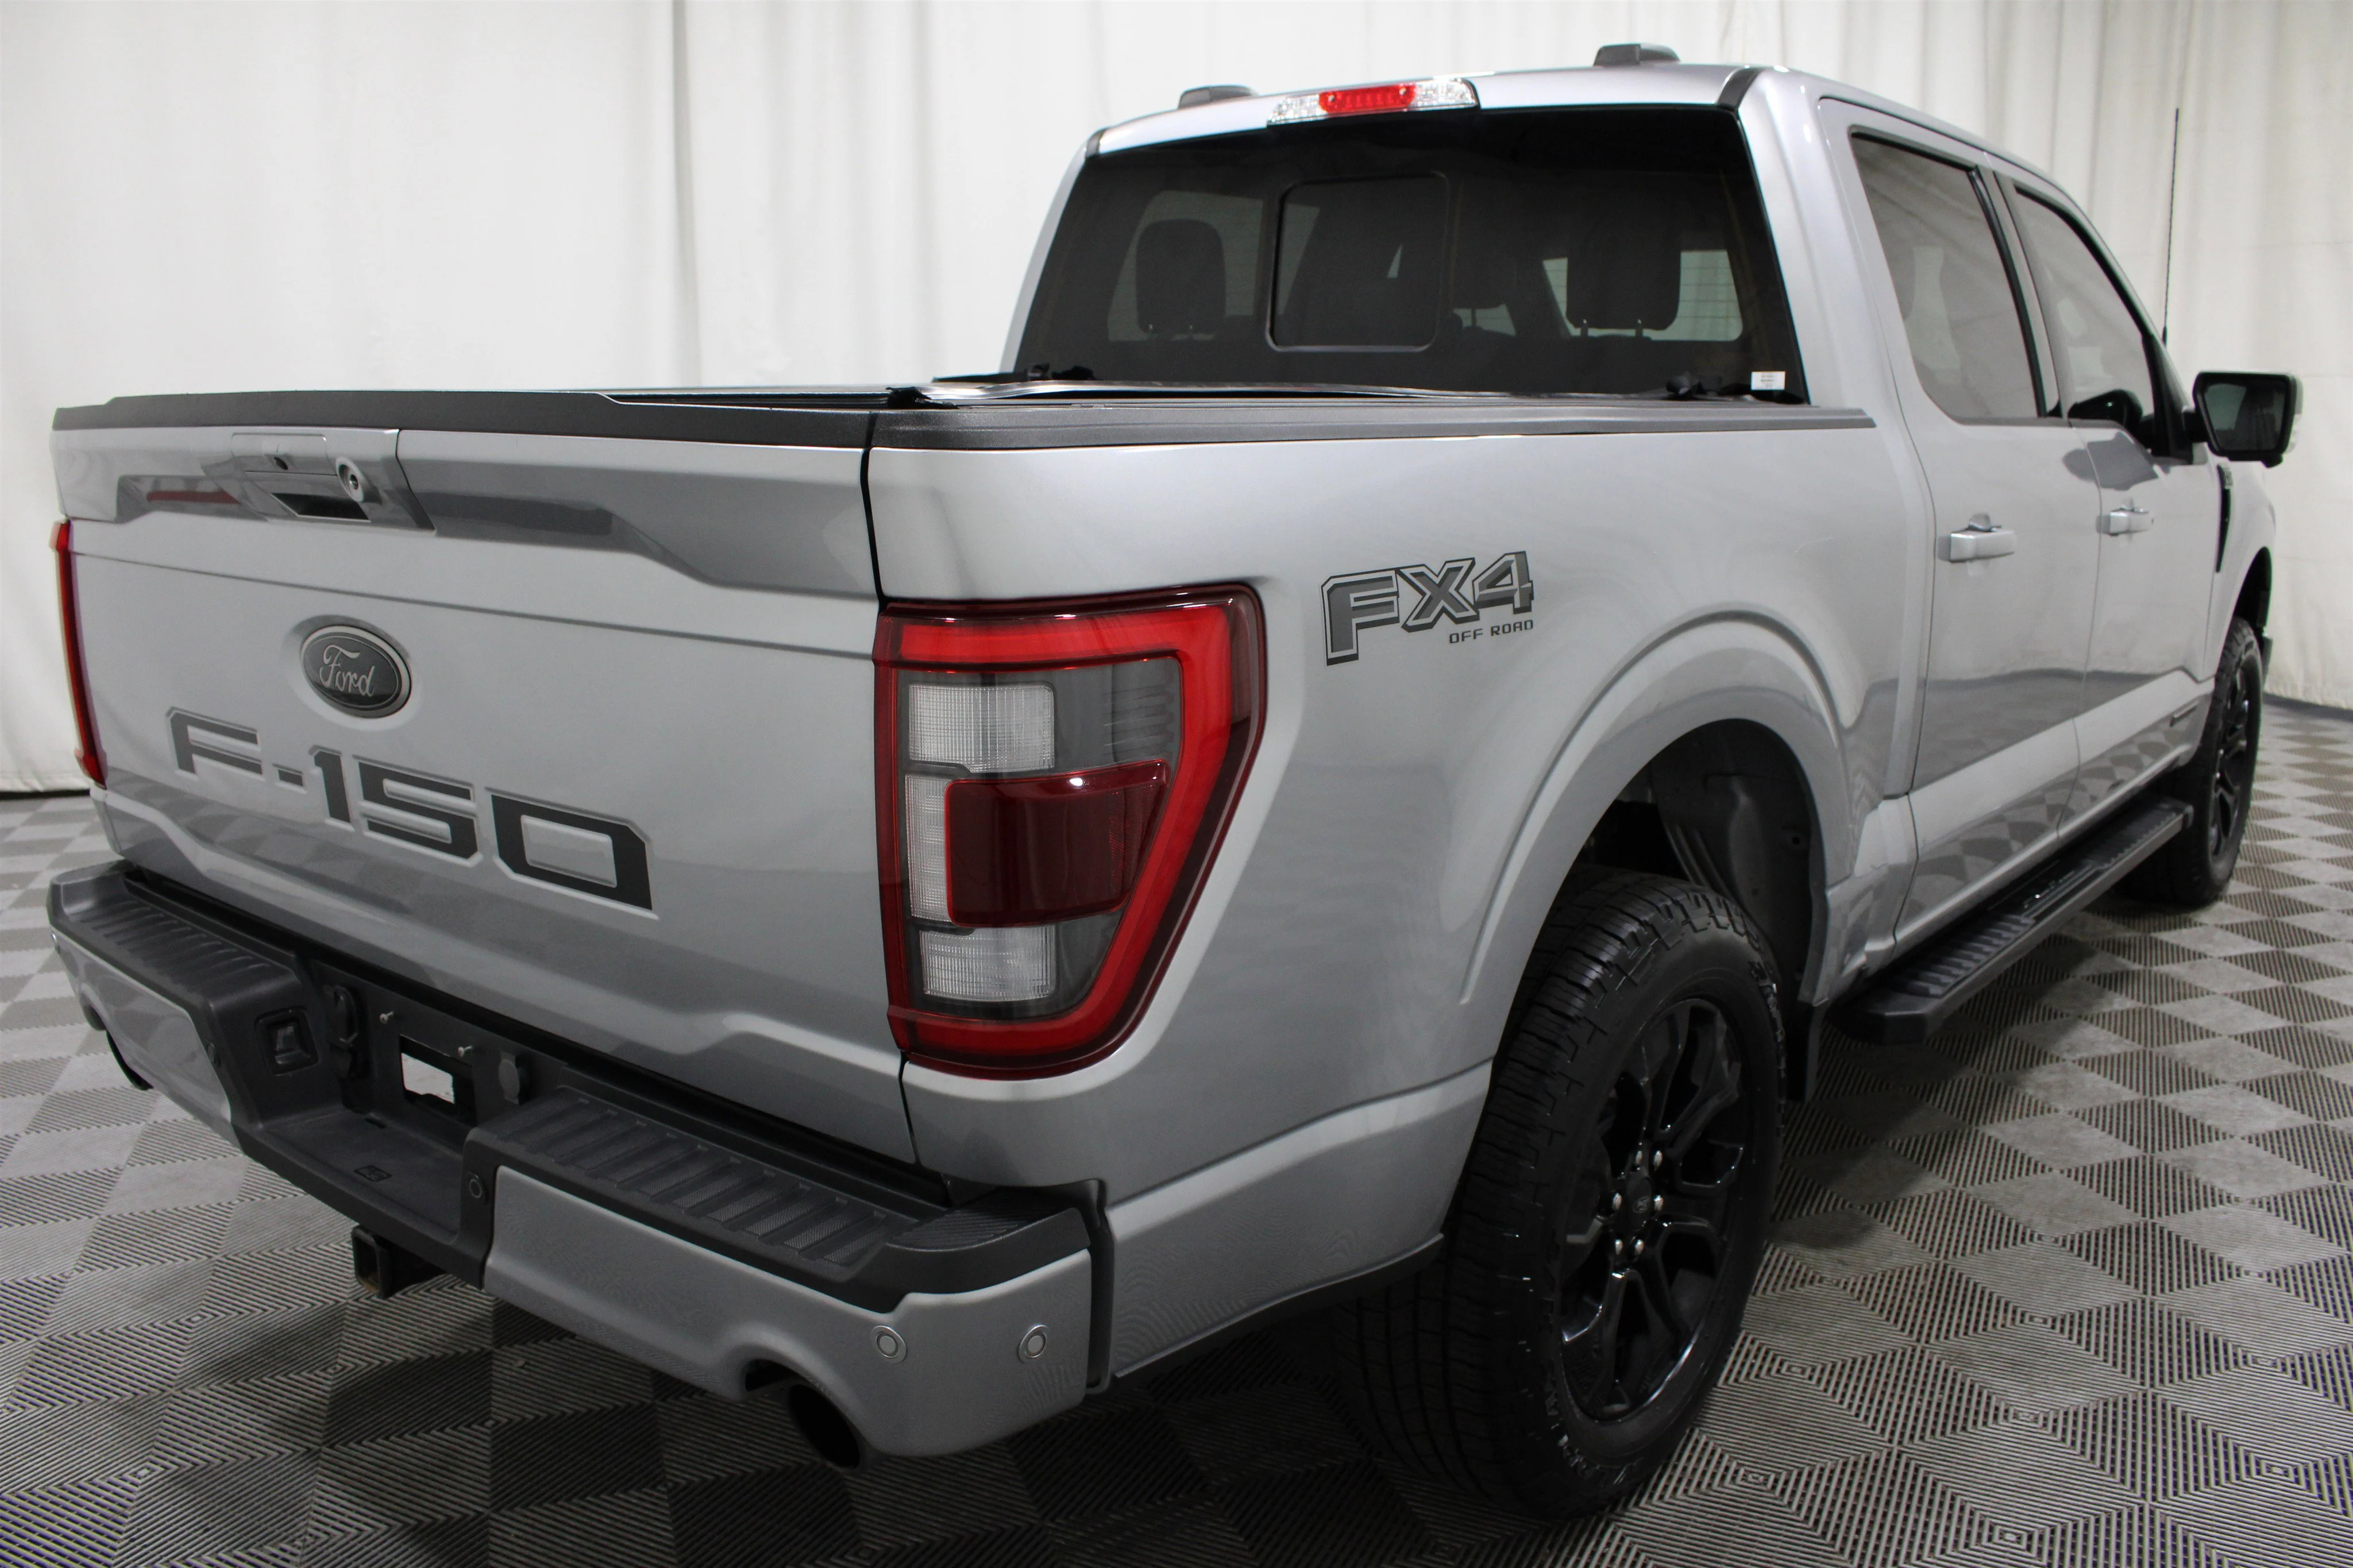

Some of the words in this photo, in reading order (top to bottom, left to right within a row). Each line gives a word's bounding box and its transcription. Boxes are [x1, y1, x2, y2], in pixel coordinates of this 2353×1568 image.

[1321, 551, 1534, 666] FX4
[1449, 628, 1483, 644] OFF
[1491, 620, 1534, 636] ROAD
[319, 644, 375, 697] Ford
[168, 708, 655, 914] F-150
